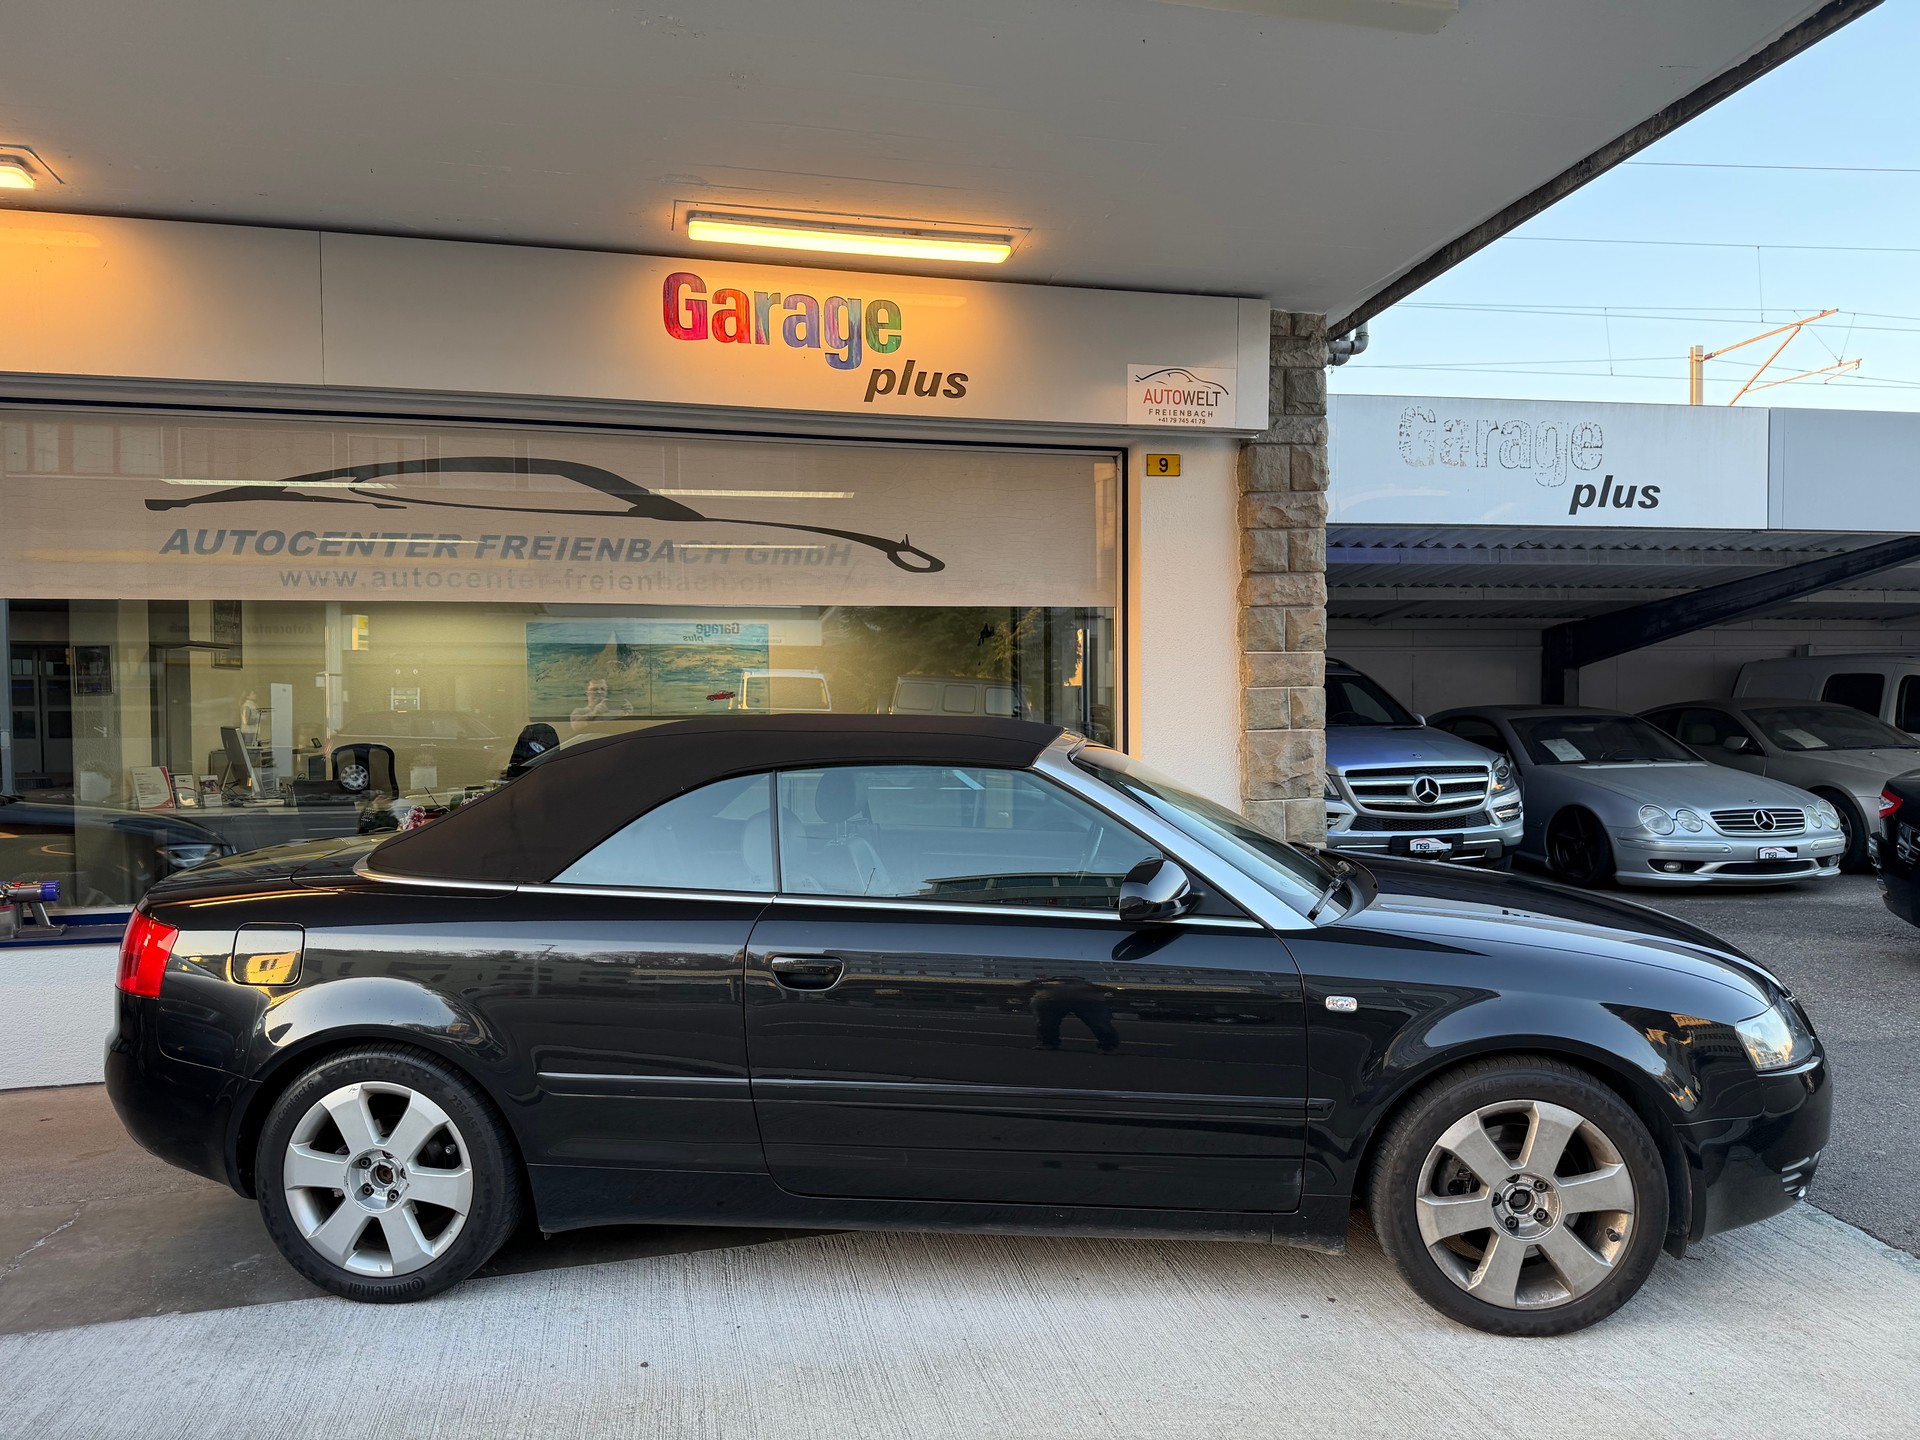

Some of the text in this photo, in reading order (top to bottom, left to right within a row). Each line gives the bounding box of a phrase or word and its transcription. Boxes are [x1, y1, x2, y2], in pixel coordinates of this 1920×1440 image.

[662, 272, 902, 370] Garage
[864, 360, 969, 402] plus
[1143, 388, 1221, 407] AUTOWELT
[1148, 408, 1214, 418] FREIENBACH
[1159, 457, 1169, 473] 9
[1399, 406, 1603, 488] Garage
[1568, 475, 1661, 516] plus
[158, 528, 854, 567] AUTOCENTER FREIENBACH GmbH
[348, 1276, 426, 1297] Continental
